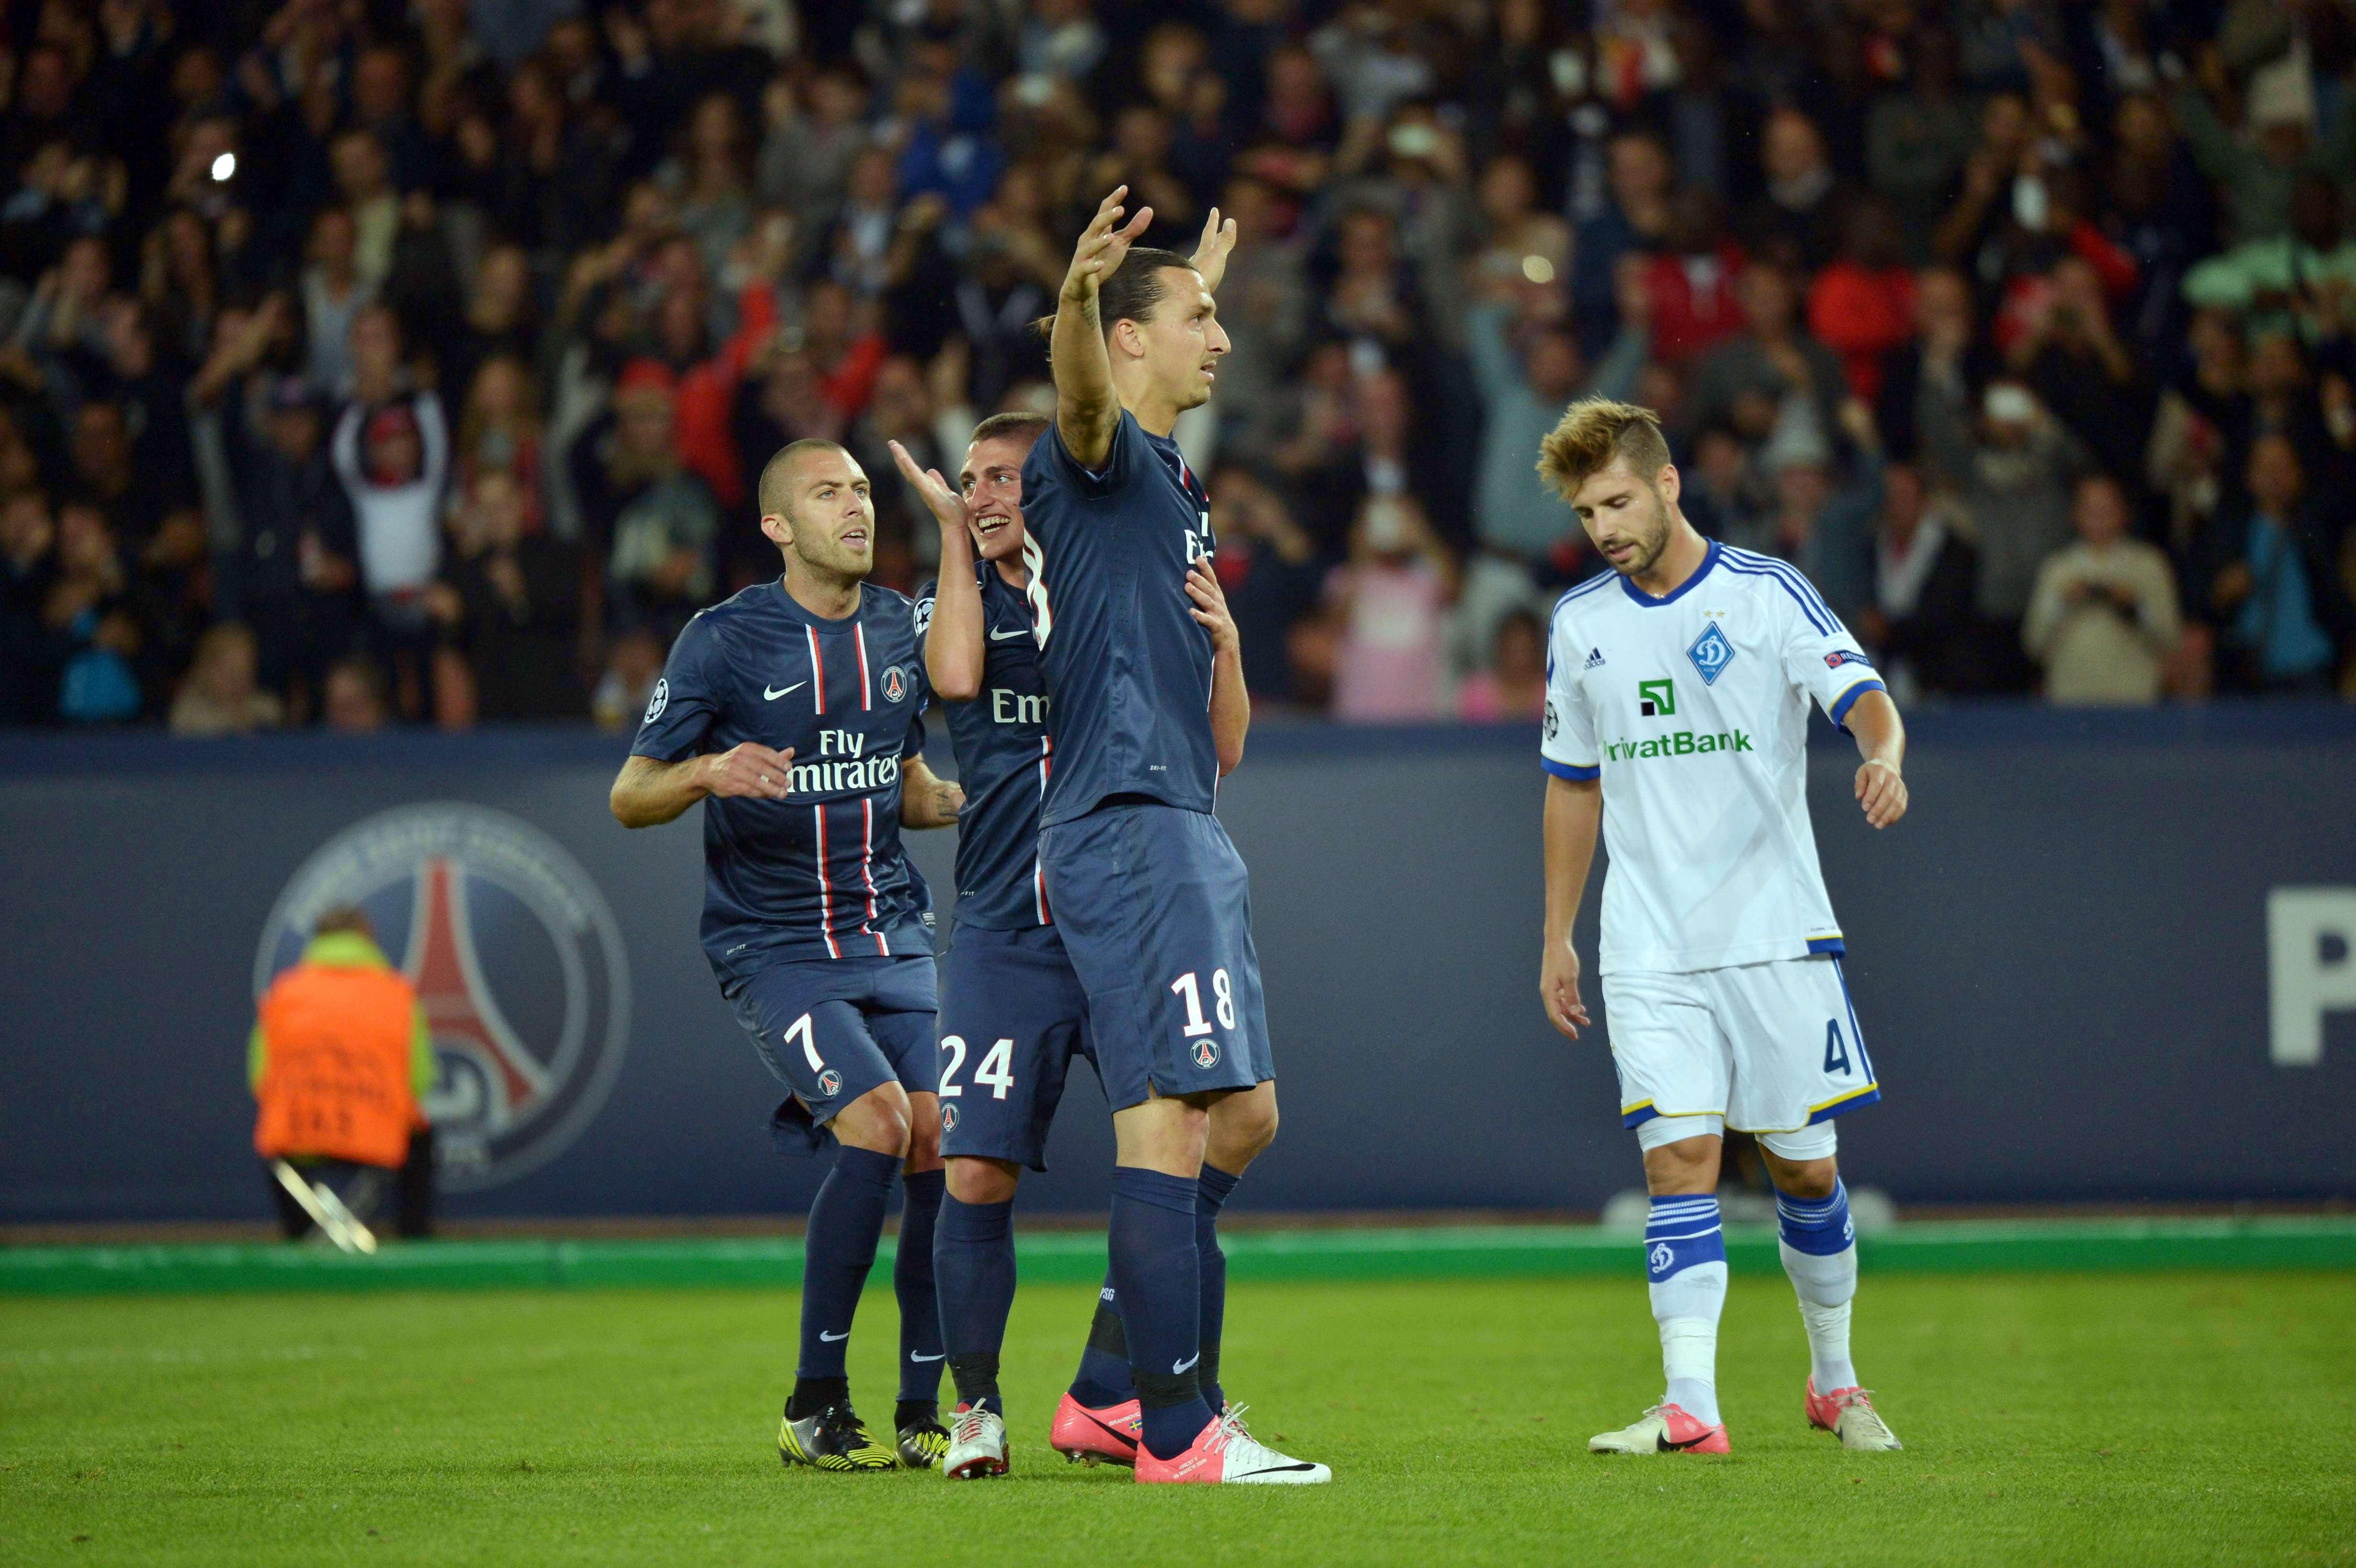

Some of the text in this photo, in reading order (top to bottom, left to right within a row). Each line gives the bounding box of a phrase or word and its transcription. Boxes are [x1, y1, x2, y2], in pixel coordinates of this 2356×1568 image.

[1583, 659, 1605, 670] adidas
[786, 755, 898, 793] mirates
[819, 730, 864, 759] Fly
[1171, 968, 1236, 1037] 18
[784, 1013, 826, 1073] 7
[938, 1035, 1014, 1099] 24
[1823, 1017, 1851, 1076] 4
